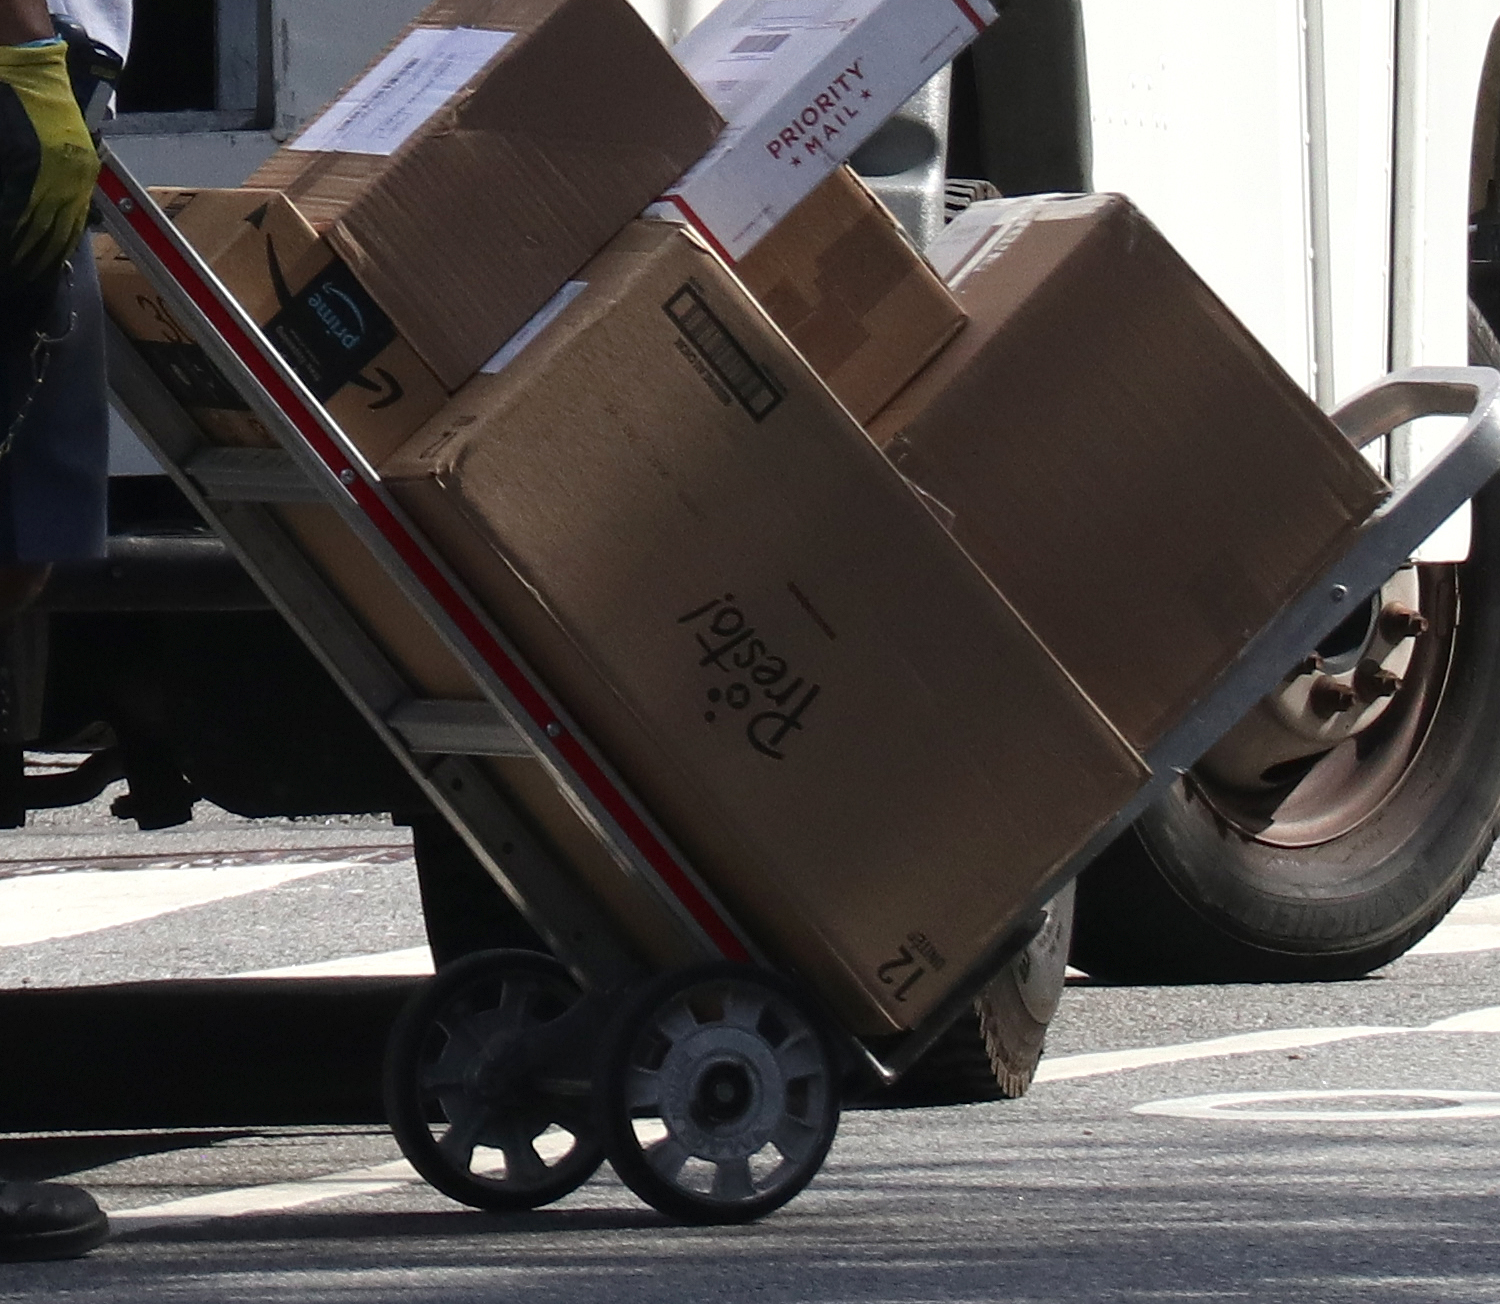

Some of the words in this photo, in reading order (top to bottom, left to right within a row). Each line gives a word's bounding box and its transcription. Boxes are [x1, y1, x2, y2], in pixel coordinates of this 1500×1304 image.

[766, 59, 869, 161] PRIORITY
[804, 104, 859, 156] MAIL
[308, 292, 361, 350] prime
[677, 593, 822, 761] Presto!
[877, 945, 926, 1002] 12
